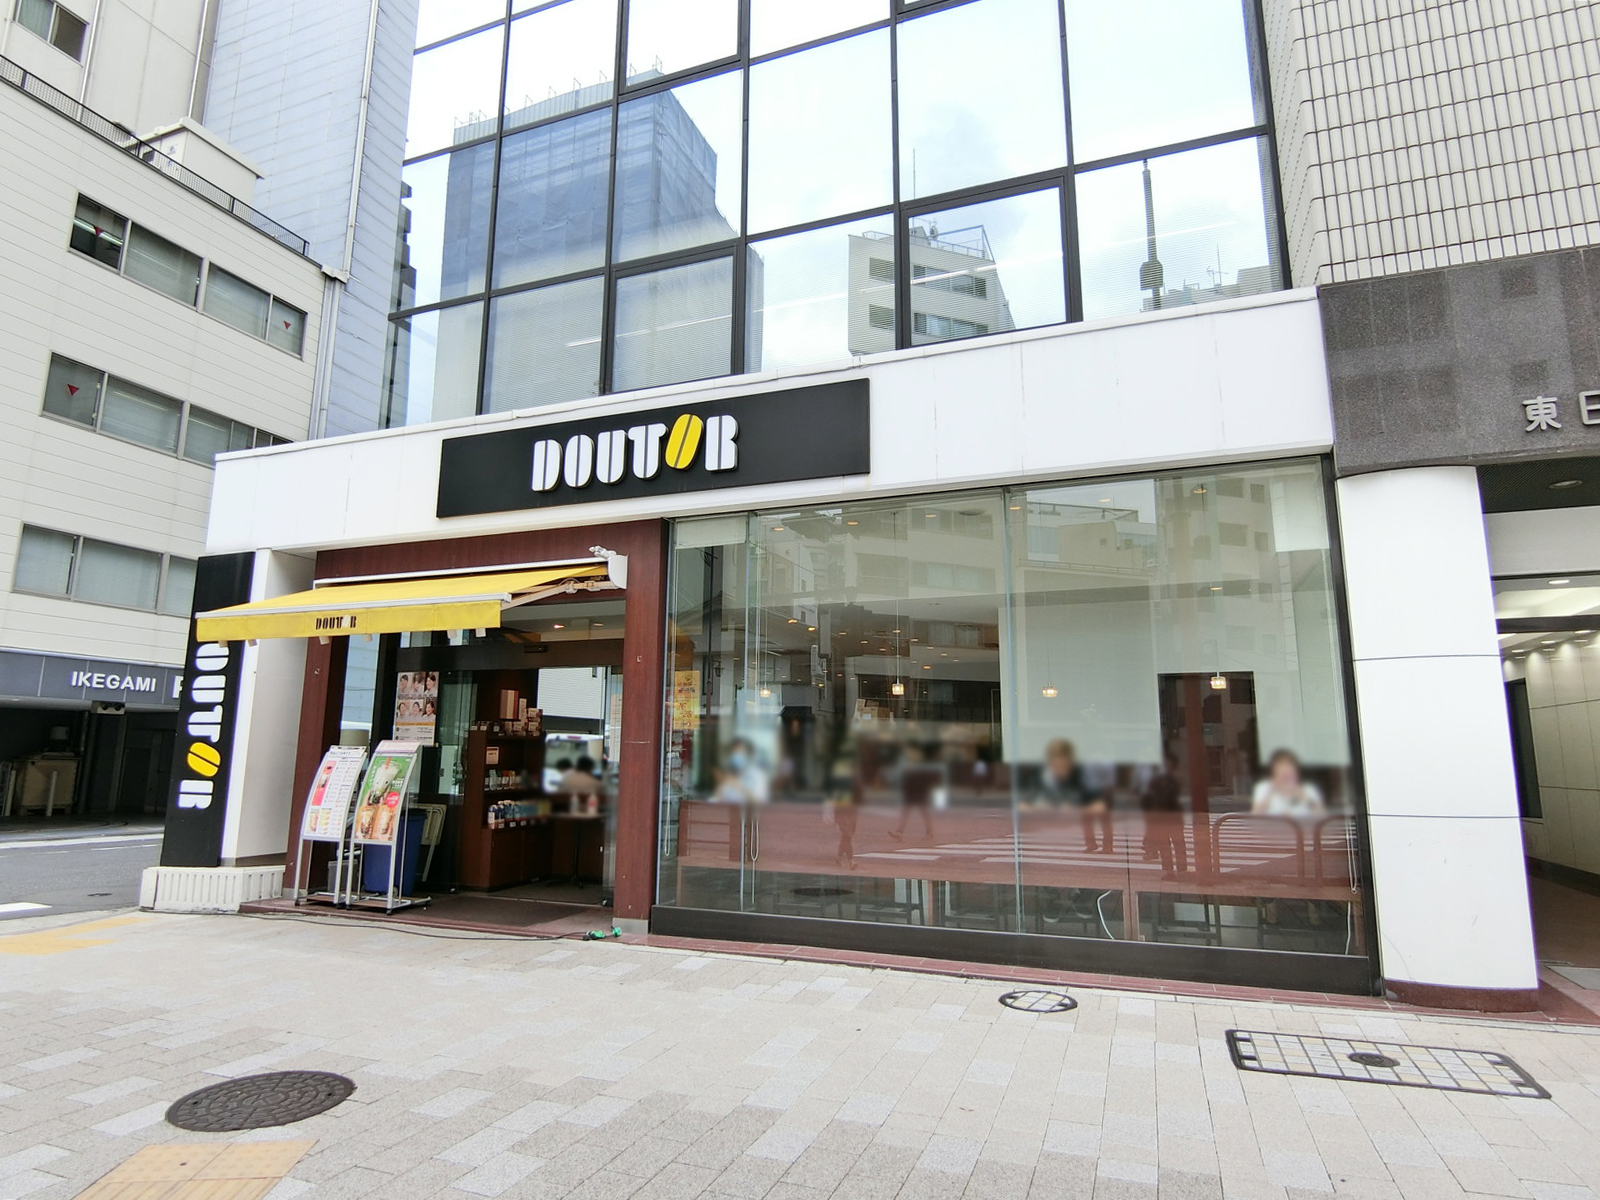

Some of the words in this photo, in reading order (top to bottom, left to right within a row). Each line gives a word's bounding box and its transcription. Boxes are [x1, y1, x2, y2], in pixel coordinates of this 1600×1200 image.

[531, 413, 738, 492] DOUTOR
[315, 614, 357, 630] DOUTOR
[70, 671, 156, 692] IKEGAMI
[178, 643, 230, 810] OUTOR
